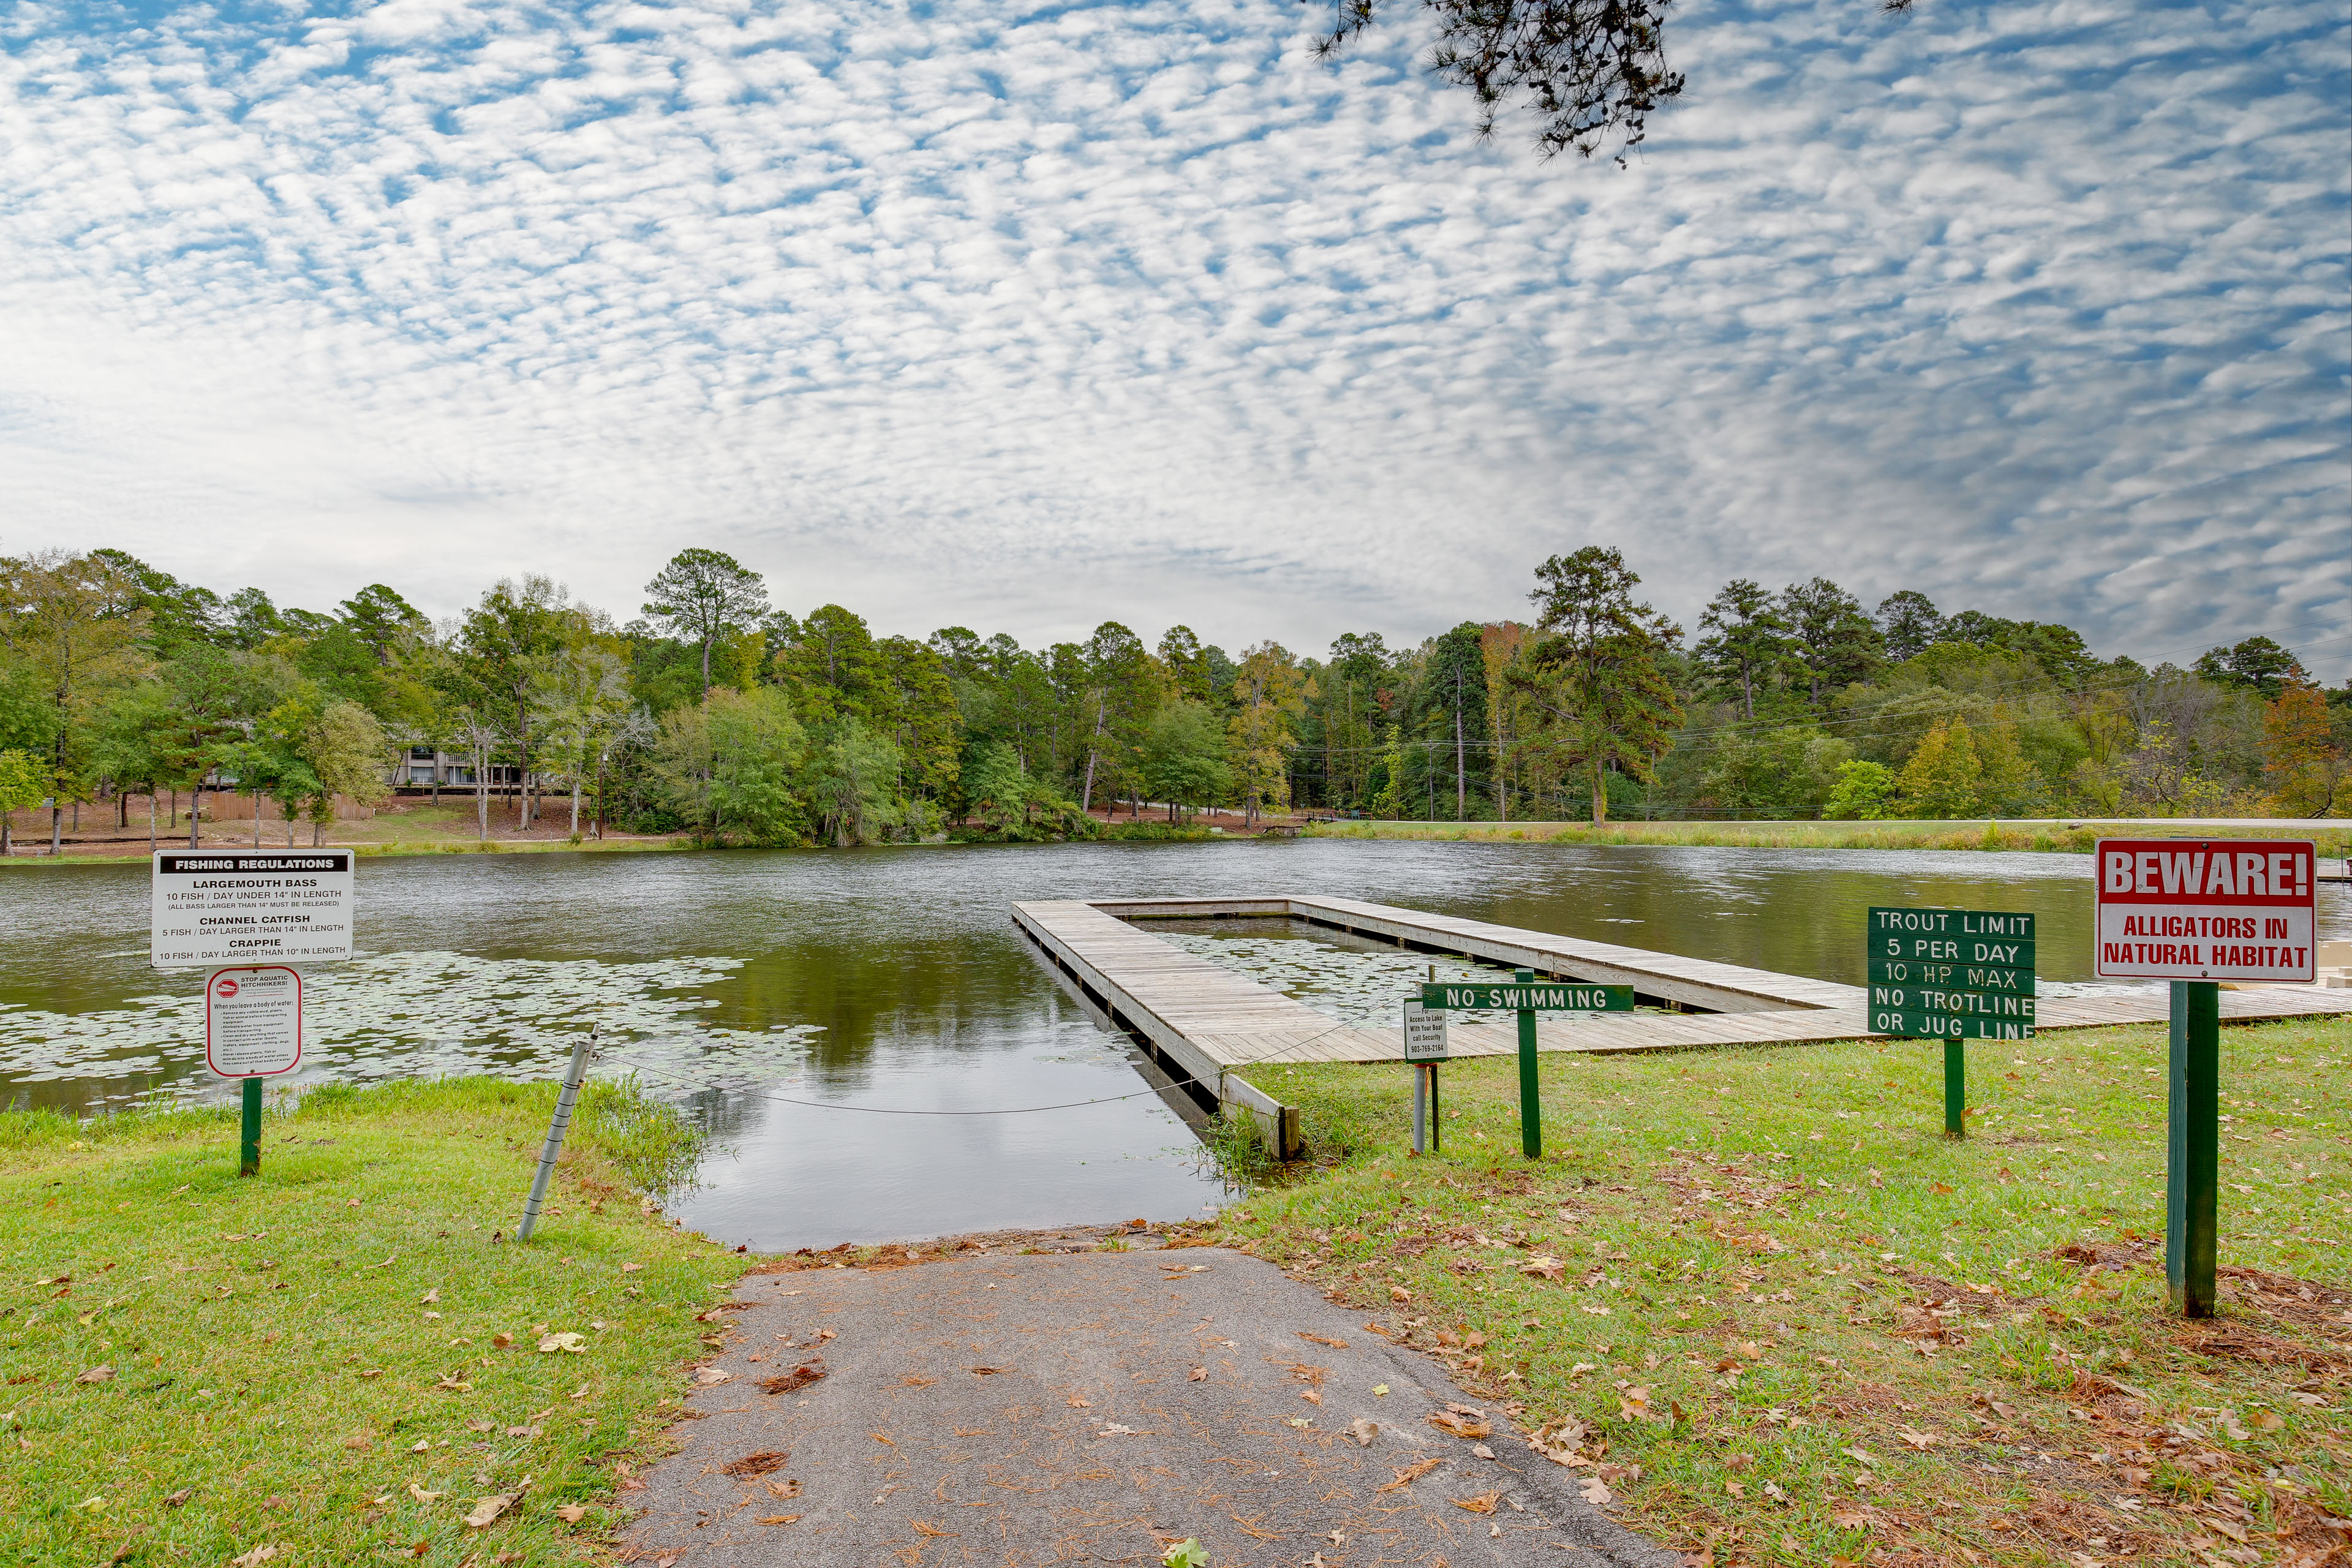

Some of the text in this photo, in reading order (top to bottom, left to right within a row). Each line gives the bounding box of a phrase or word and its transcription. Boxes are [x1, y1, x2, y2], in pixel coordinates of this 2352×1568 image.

[176, 859, 334, 870] FISHING REGULATIONS
[2105, 852, 2307, 895] BEWARE!
[1877, 911, 2030, 935] TROUT LIMIT
[2124, 916, 2287, 939] ALLIGATORS IN
[230, 939, 281, 948] CRAPPIE
[1887, 938, 2019, 963] 5 PER DAY
[2105, 943, 2307, 968] NATURAL HABITAT
[1886, 963, 2016, 989] 10 HP MAX
[1446, 988, 1606, 1008] NO SWIMMING
[1875, 987, 2034, 1016] NO TROTLINE
[1877, 1012, 1904, 1031] OR
[1919, 1016, 1962, 1036] JUG
